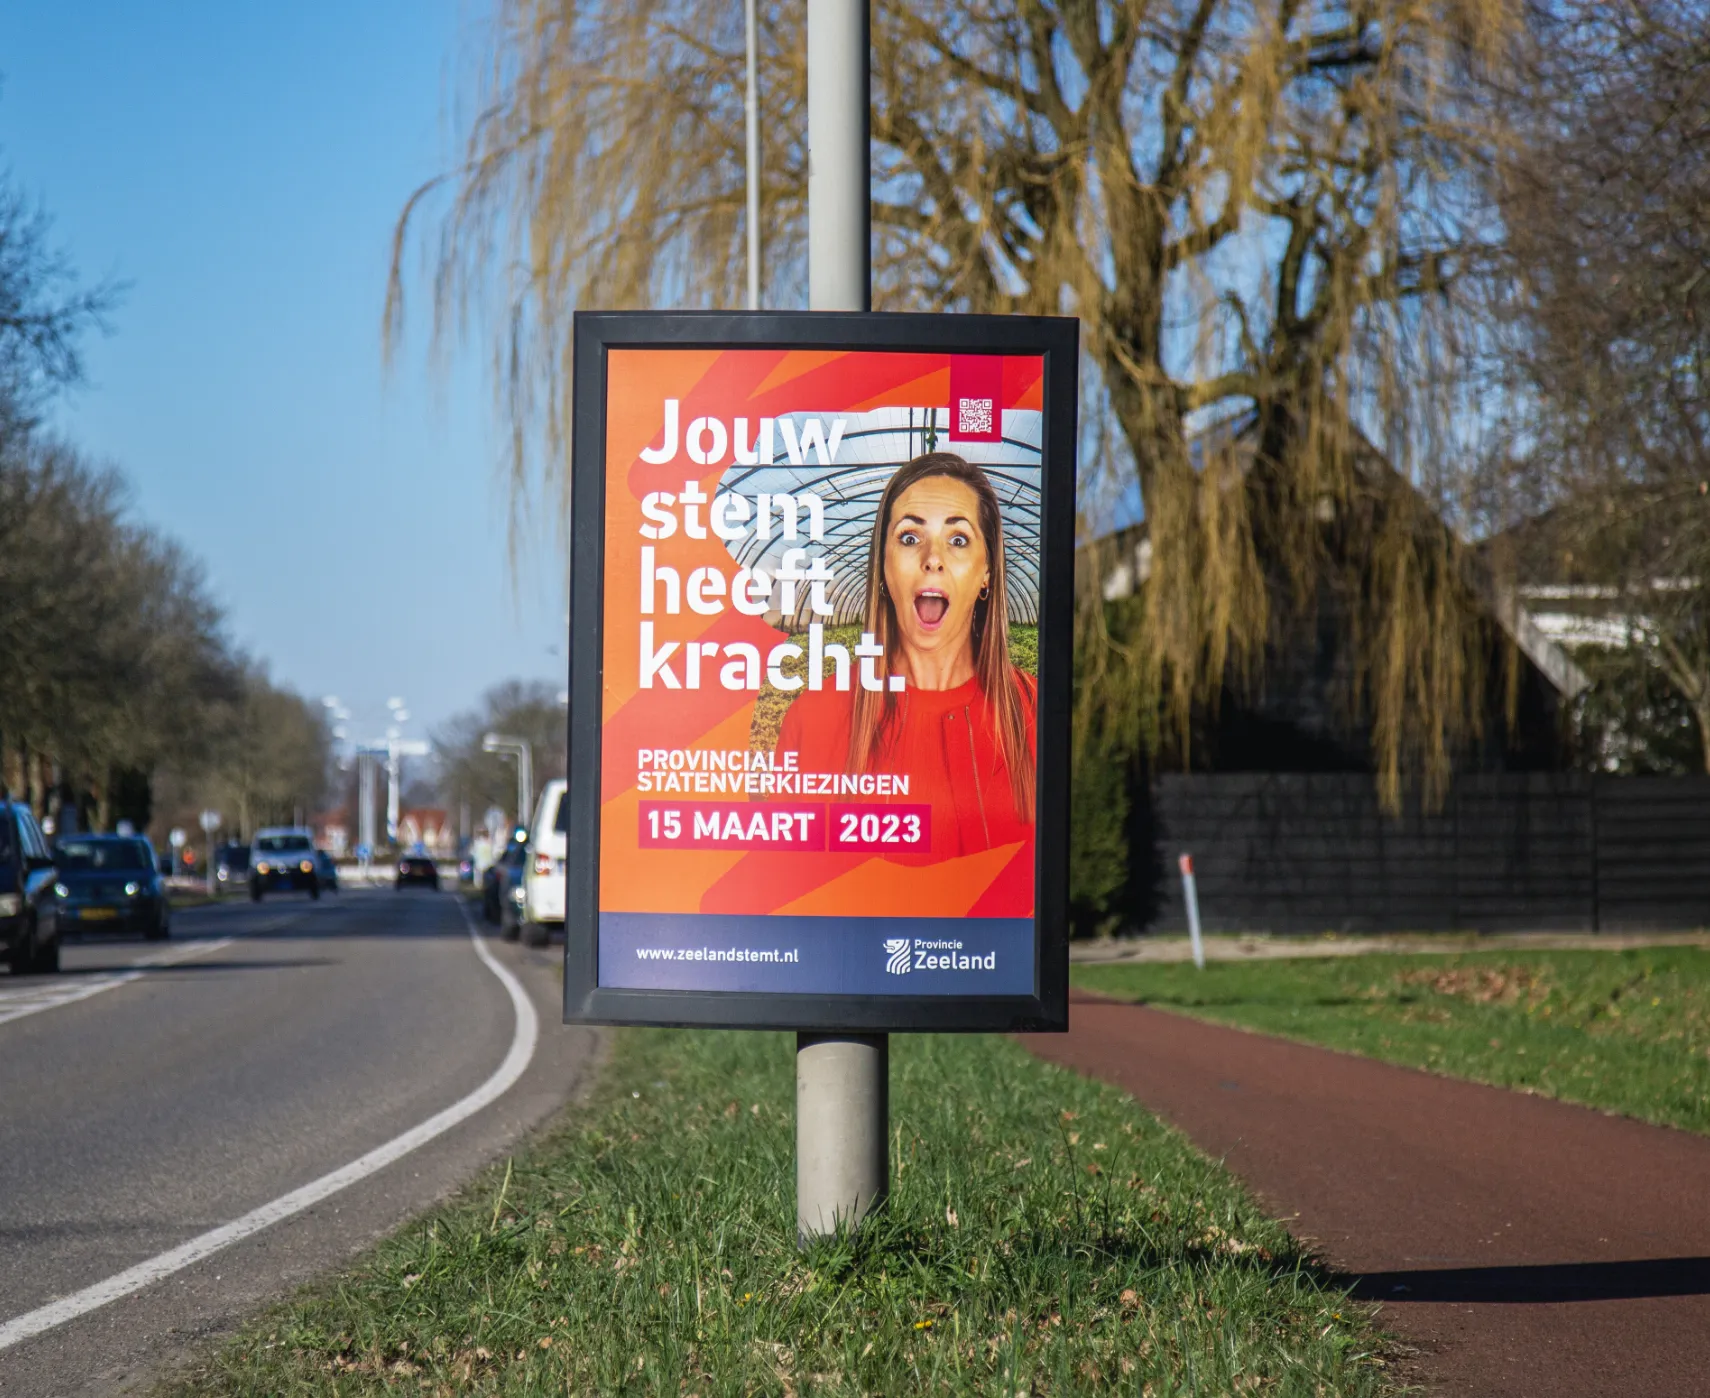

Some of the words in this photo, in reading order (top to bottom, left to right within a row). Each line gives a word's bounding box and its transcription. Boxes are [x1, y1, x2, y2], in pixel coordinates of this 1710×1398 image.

[639, 398, 847, 466] Jouw
[639, 480, 825, 541] stem
[639, 546, 834, 616] heeft
[638, 621, 906, 692] kracht.
[637, 749, 799, 772] PROVINCIALE
[636, 772, 910, 795] STATENVERKIEZINGEN
[647, 810, 682, 839] 15
[693, 811, 815, 842] MAART
[839, 814, 922, 844] 2023
[636, 946, 799, 964] www.zeelandstemt.nl
[914, 939, 963, 950] Provincie
[914, 951, 996, 971] Zeeland
